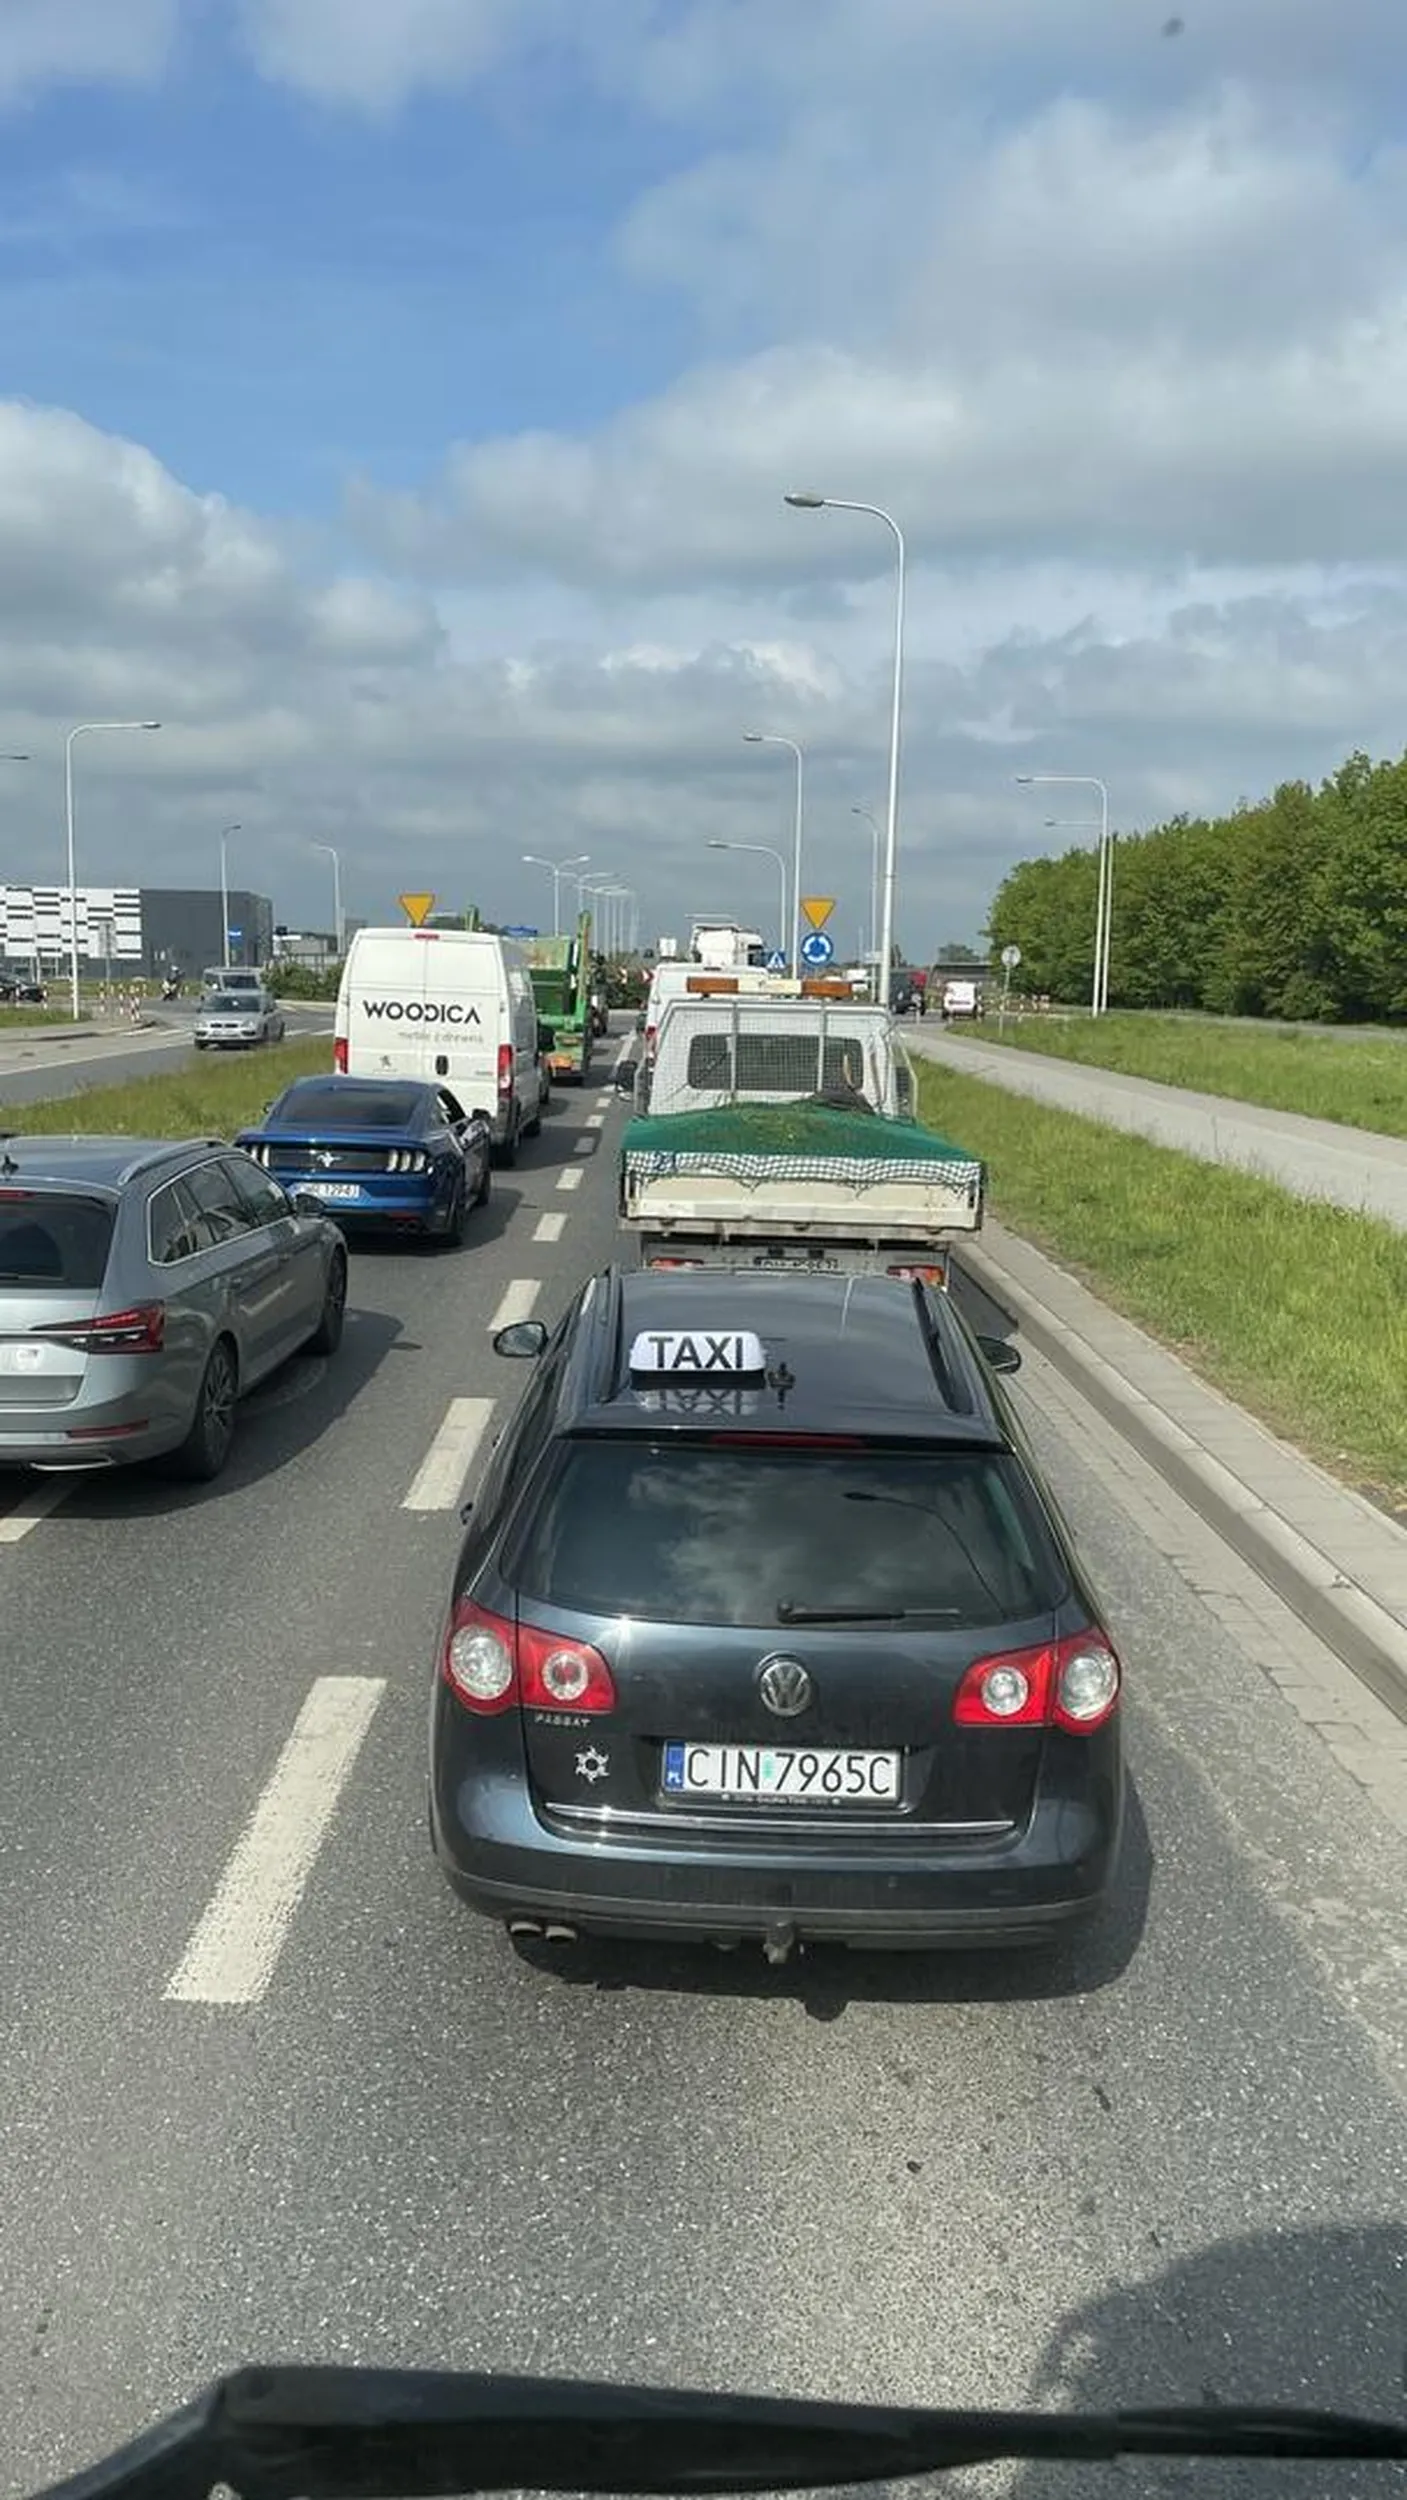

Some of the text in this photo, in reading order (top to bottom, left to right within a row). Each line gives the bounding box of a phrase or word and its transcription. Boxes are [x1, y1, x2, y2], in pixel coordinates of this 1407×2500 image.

[362, 999, 482, 1025] WOODICA
[647, 1335, 743, 1369] TAXI
[534, 1713, 591, 1727] PASSAT
[687, 1749, 890, 1794] CIN 7965C
